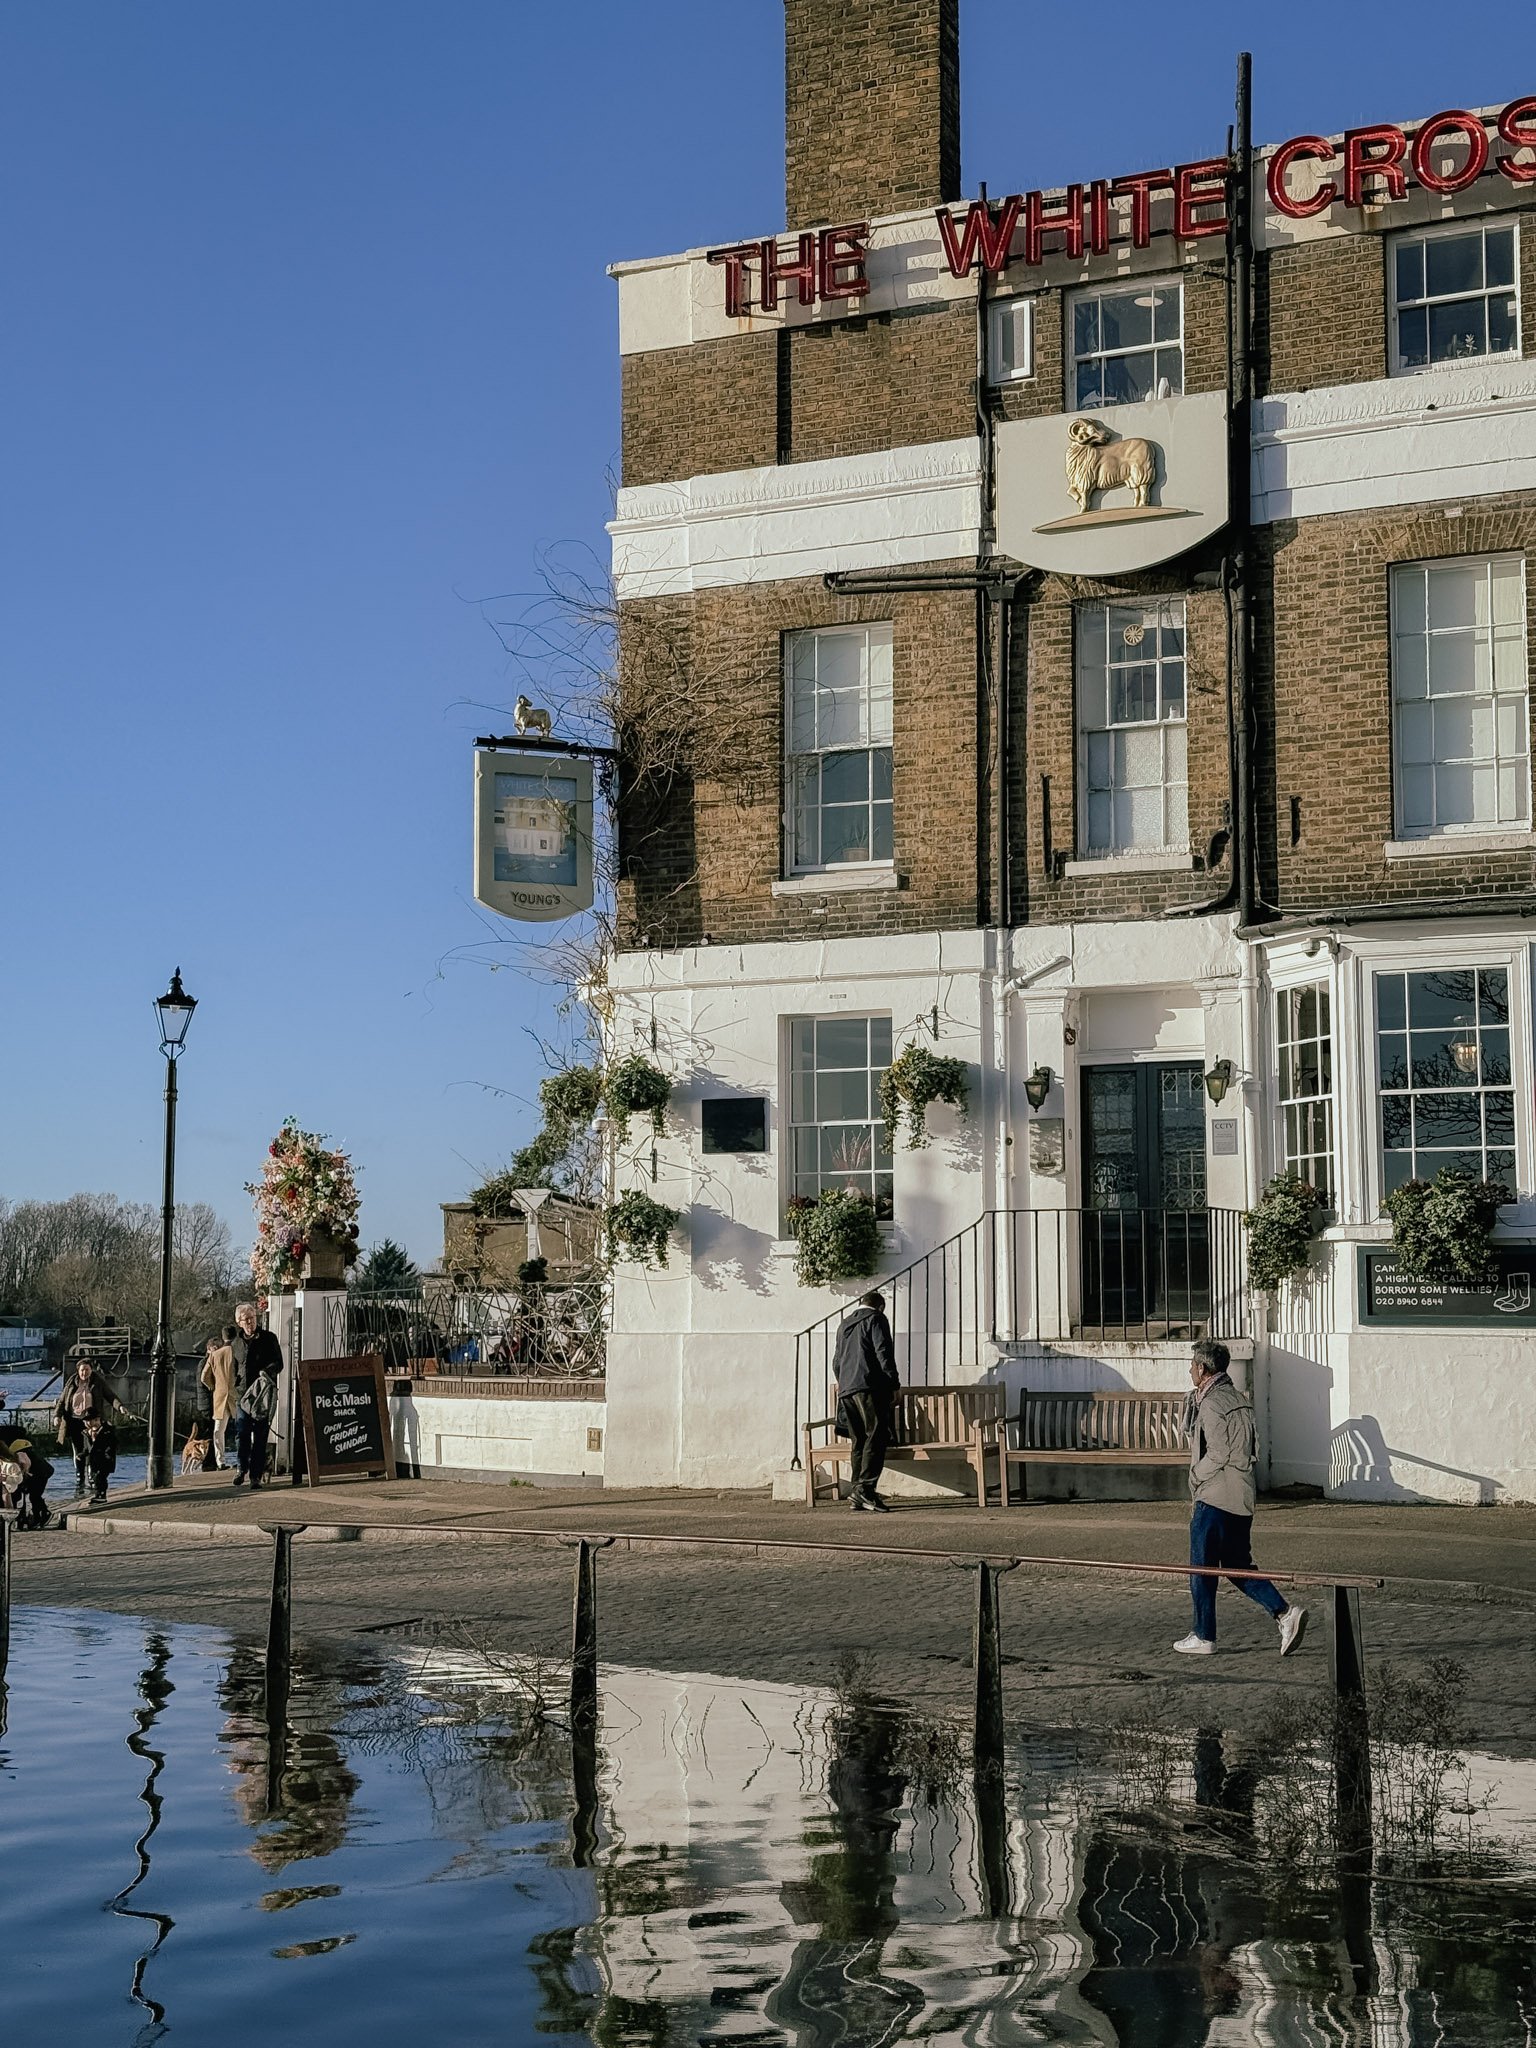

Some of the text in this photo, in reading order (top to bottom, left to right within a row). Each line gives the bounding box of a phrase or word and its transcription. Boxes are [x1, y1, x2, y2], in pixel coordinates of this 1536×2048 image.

[706, 221, 871, 318] THE
[935, 157, 1231, 279] WHITE
[511, 891, 561, 905] YOUNG'S
[1214, 1122, 1234, 1130] CCTV
[1487, 1264, 1500, 1273] OF
[1375, 1275, 1383, 1283] A
[1385, 1275, 1408, 1283] HIGH
[1442, 1274, 1468, 1283] CALL
[1470, 1274, 1484, 1283] US
[1486, 1274, 1499, 1283] TO
[1375, 1286, 1417, 1294] BORROW
[1420, 1286, 1448, 1294] SOME
[1375, 1297, 1443, 1306] 020 8940 6844
[315, 1392, 371, 1408] Pie & Mash
[333, 1408, 357, 1416] SHACK
[323, 1422, 342, 1434] OPEN
[329, 1426, 358, 1444] FRIDAY
[335, 1433, 368, 1454] SUNDAY
